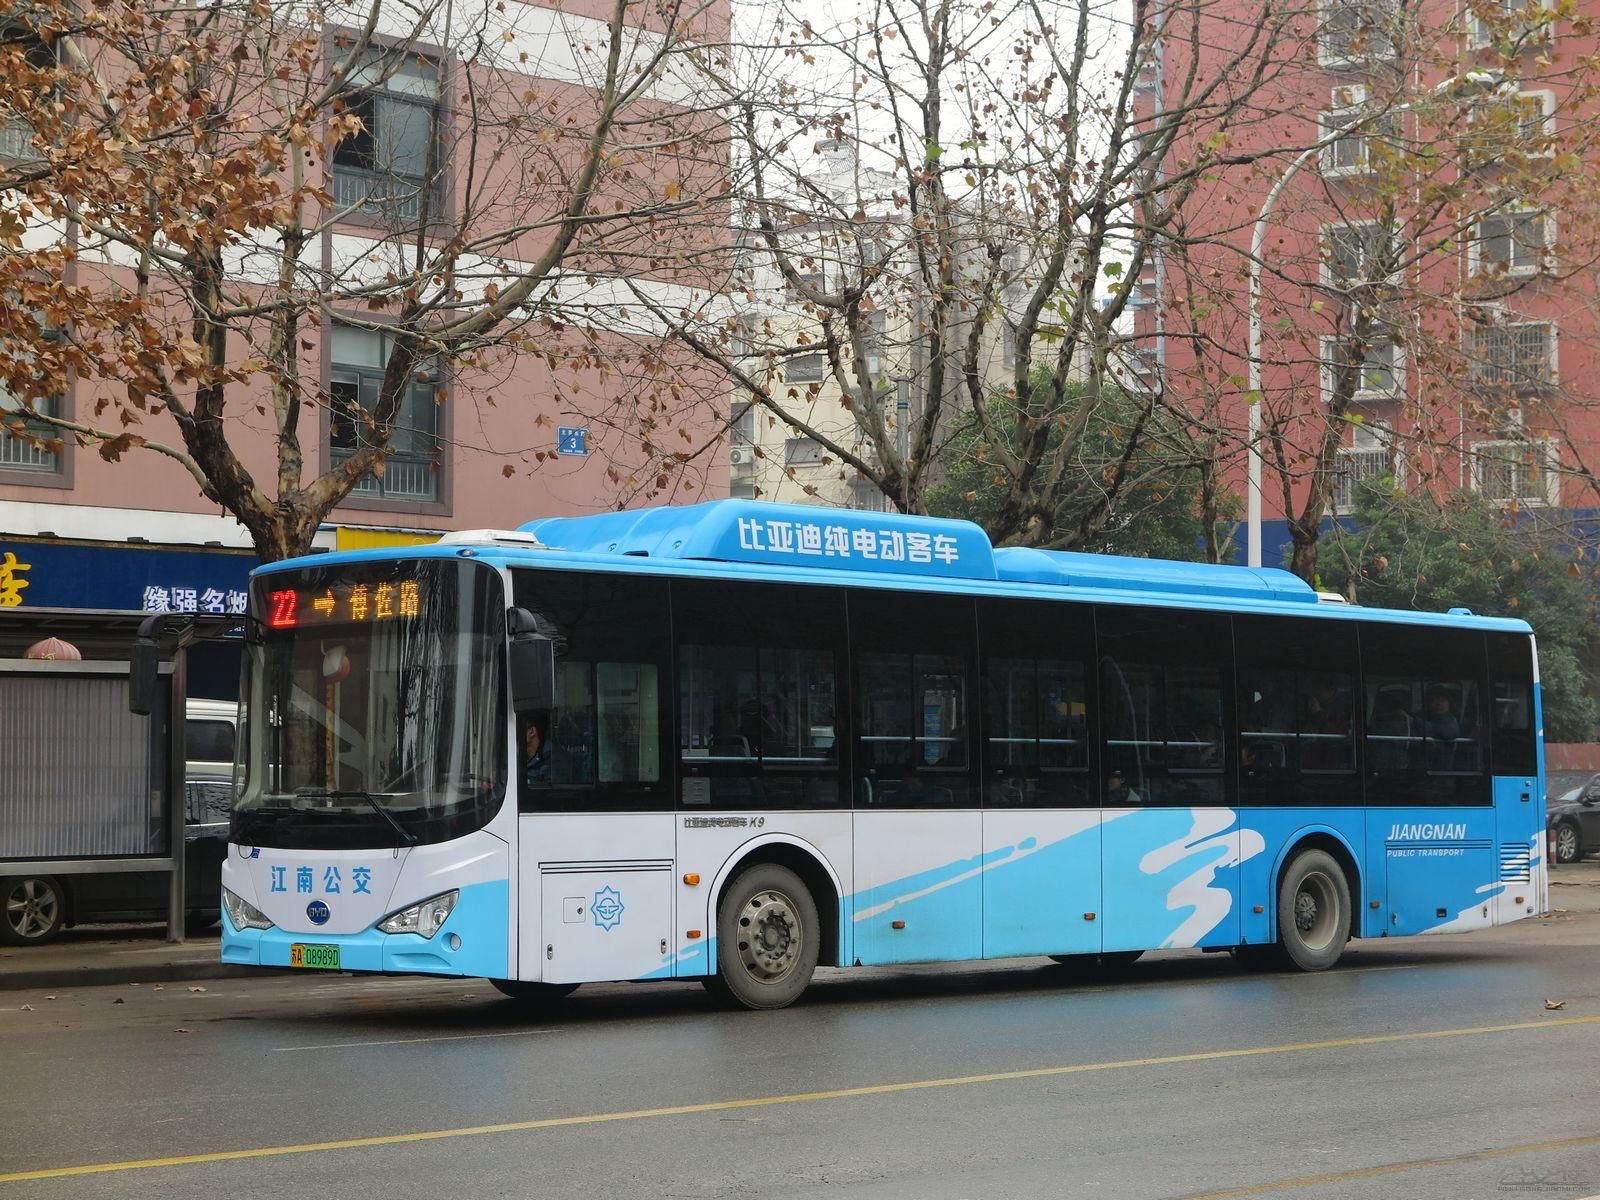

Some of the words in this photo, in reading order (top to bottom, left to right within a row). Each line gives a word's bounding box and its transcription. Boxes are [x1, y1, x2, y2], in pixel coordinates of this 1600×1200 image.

[570, 437, 577, 449] 3
[738, 517, 959, 565] 比亚迪纯电动客车
[272, 589, 296, 626] 22
[749, 816, 765, 828] K9
[1387, 823, 1467, 841] JIANGNAN
[1387, 849, 1416, 858] PUBLIC
[1418, 848, 1465, 857] TRANSPORT
[270, 865, 371, 895] 江南公交
